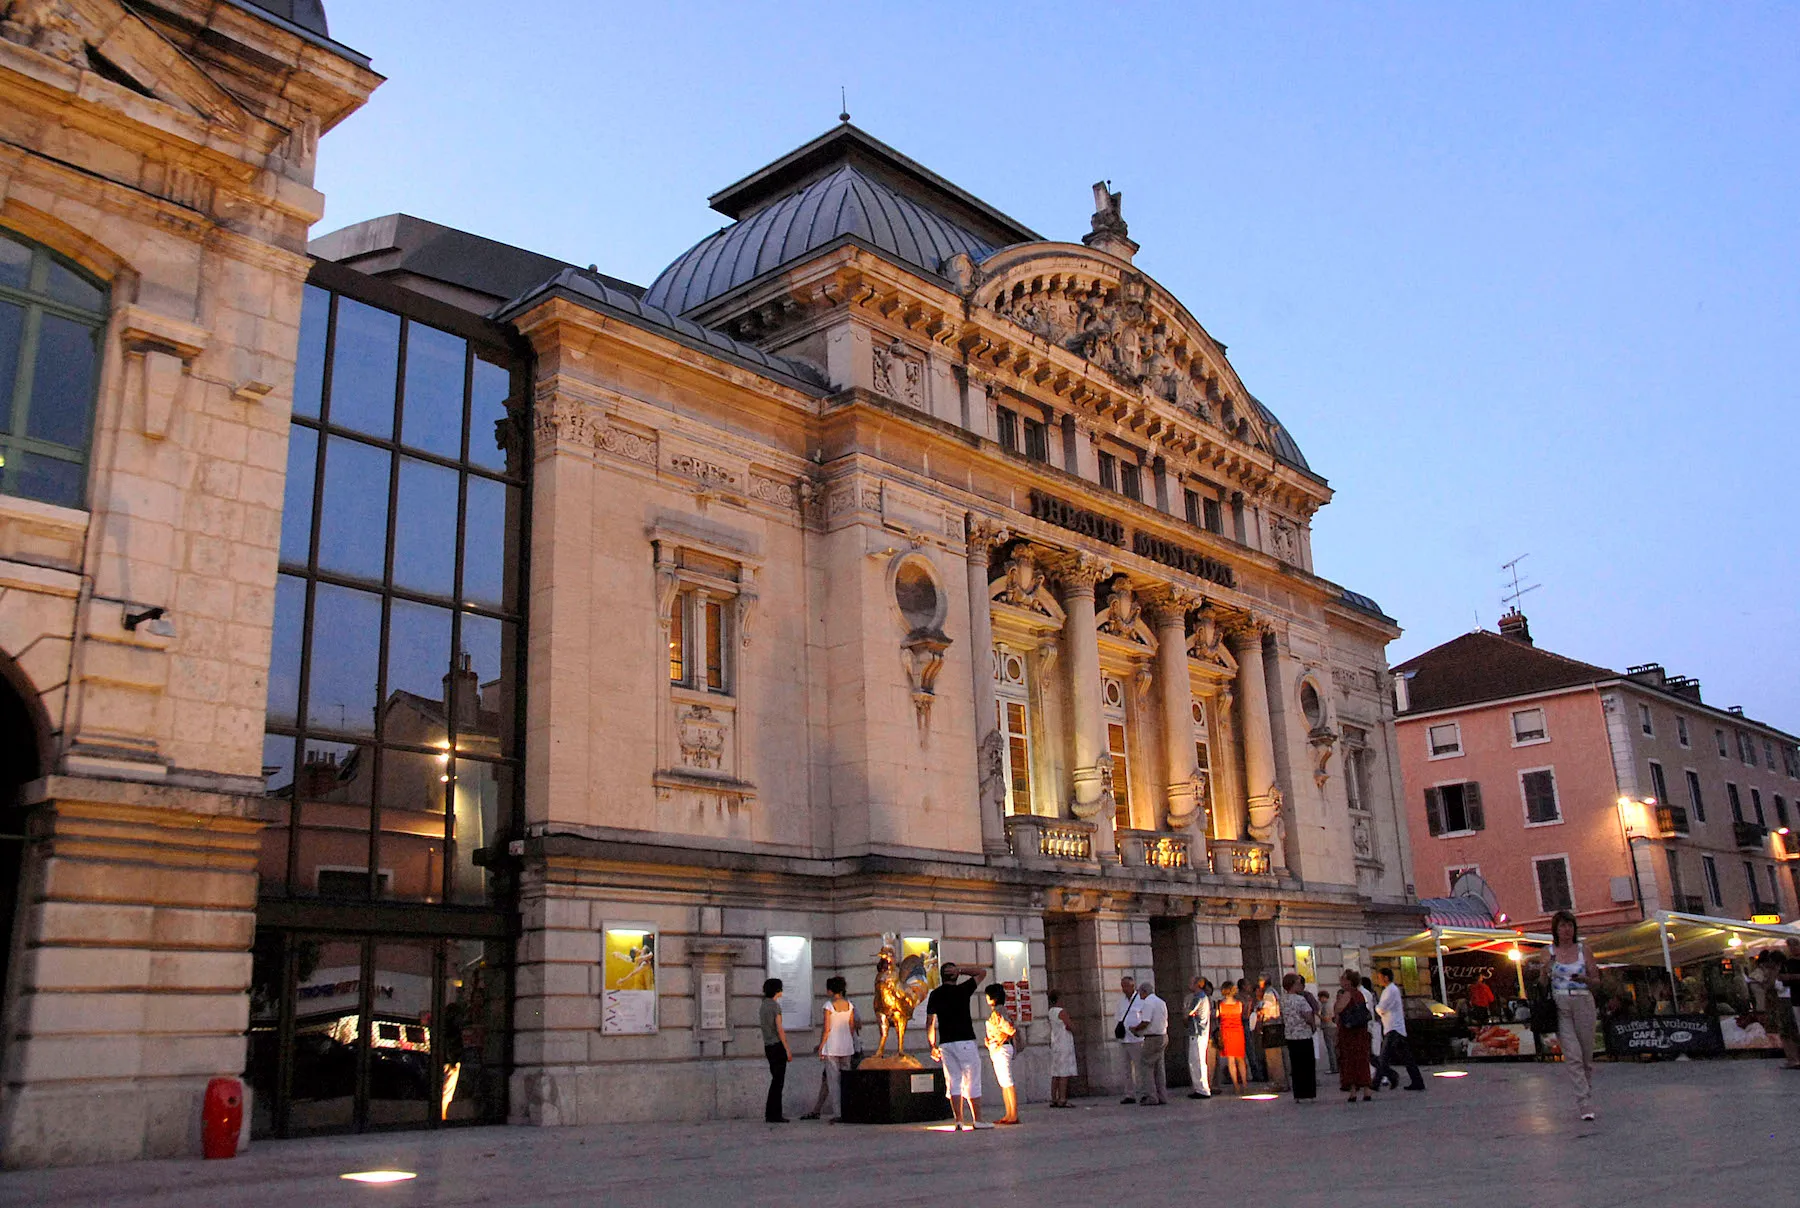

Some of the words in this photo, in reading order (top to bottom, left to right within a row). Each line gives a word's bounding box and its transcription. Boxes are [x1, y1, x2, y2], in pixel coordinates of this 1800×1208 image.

[1133, 528, 1237, 589] MUNICIPAL
[1615, 1020, 1650, 1034] Buffet
[1663, 1019, 1708, 1032] volonté
[1633, 1029, 1656, 1039] CAFÉ
[1628, 1039, 1662, 1048] OFFERT
